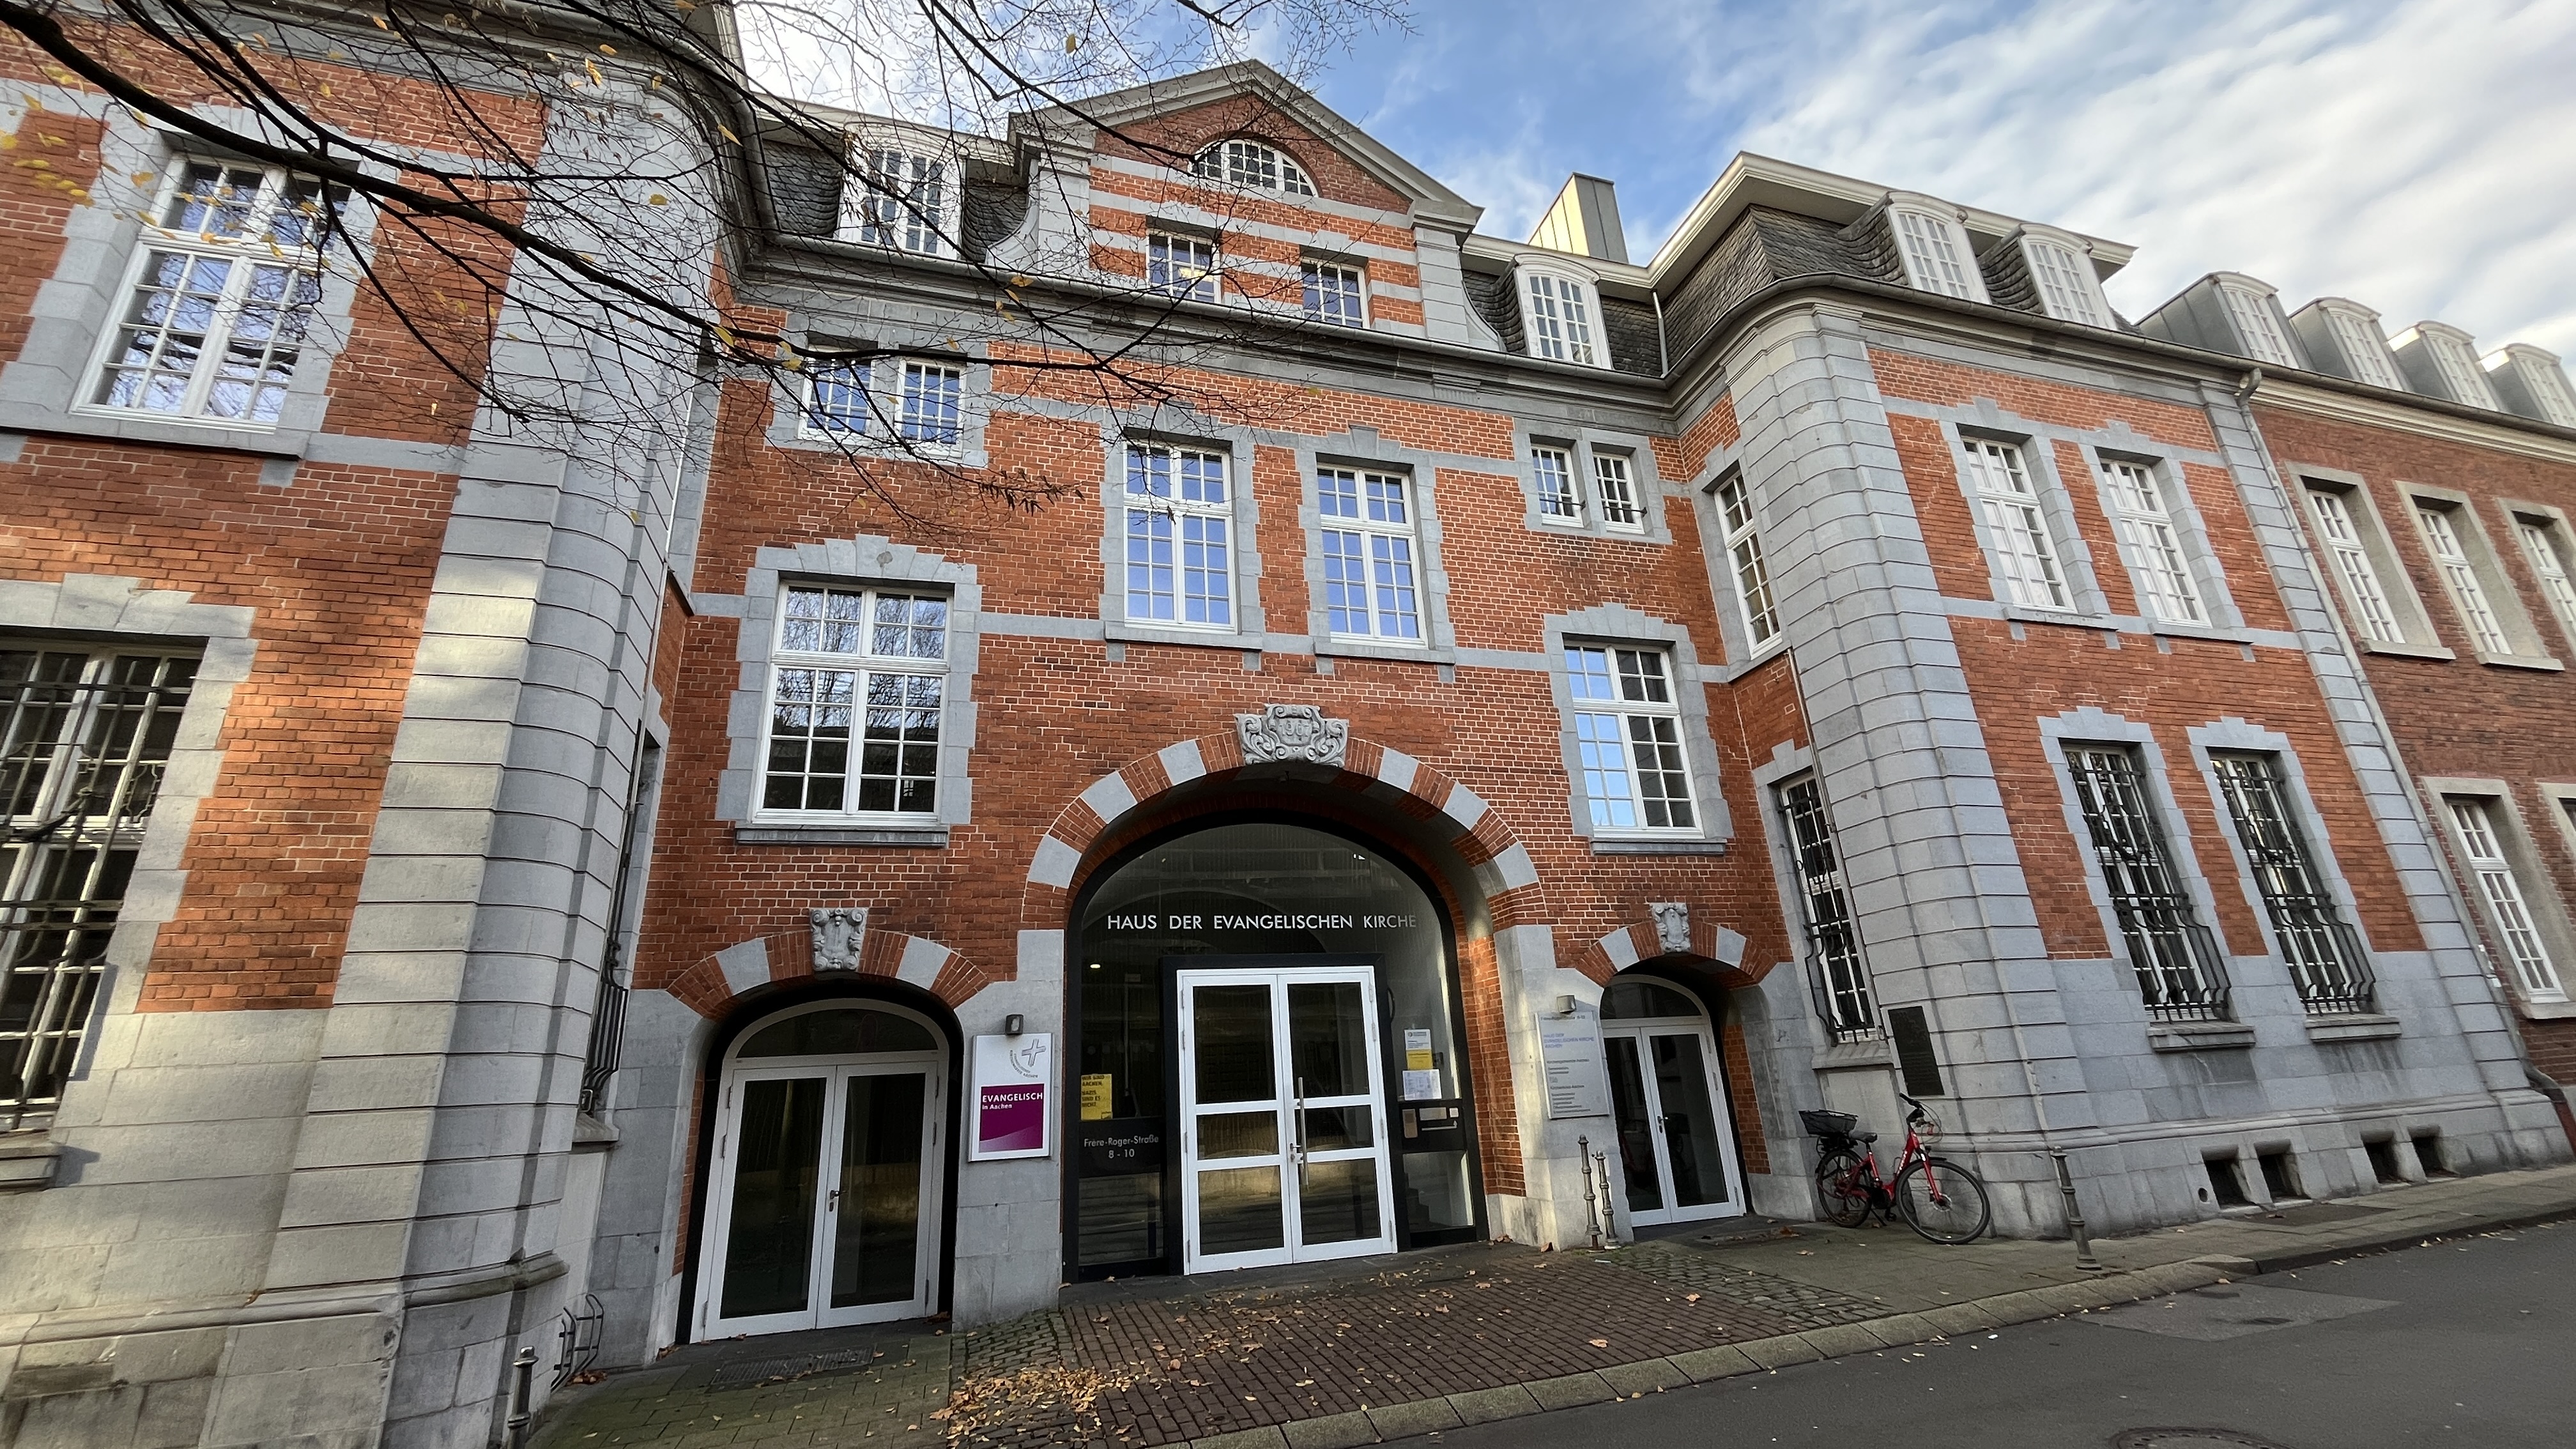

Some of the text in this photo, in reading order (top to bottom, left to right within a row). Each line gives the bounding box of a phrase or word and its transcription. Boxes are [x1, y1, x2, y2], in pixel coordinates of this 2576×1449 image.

[1107, 914, 1416, 930] HAUS DER EVANGELISCHEN KIRCHE
[982, 1092, 1043, 1103] EVANGELISCH
[1108, 1150, 1114, 1158] 8
[1124, 1149, 1135, 1158] 10
